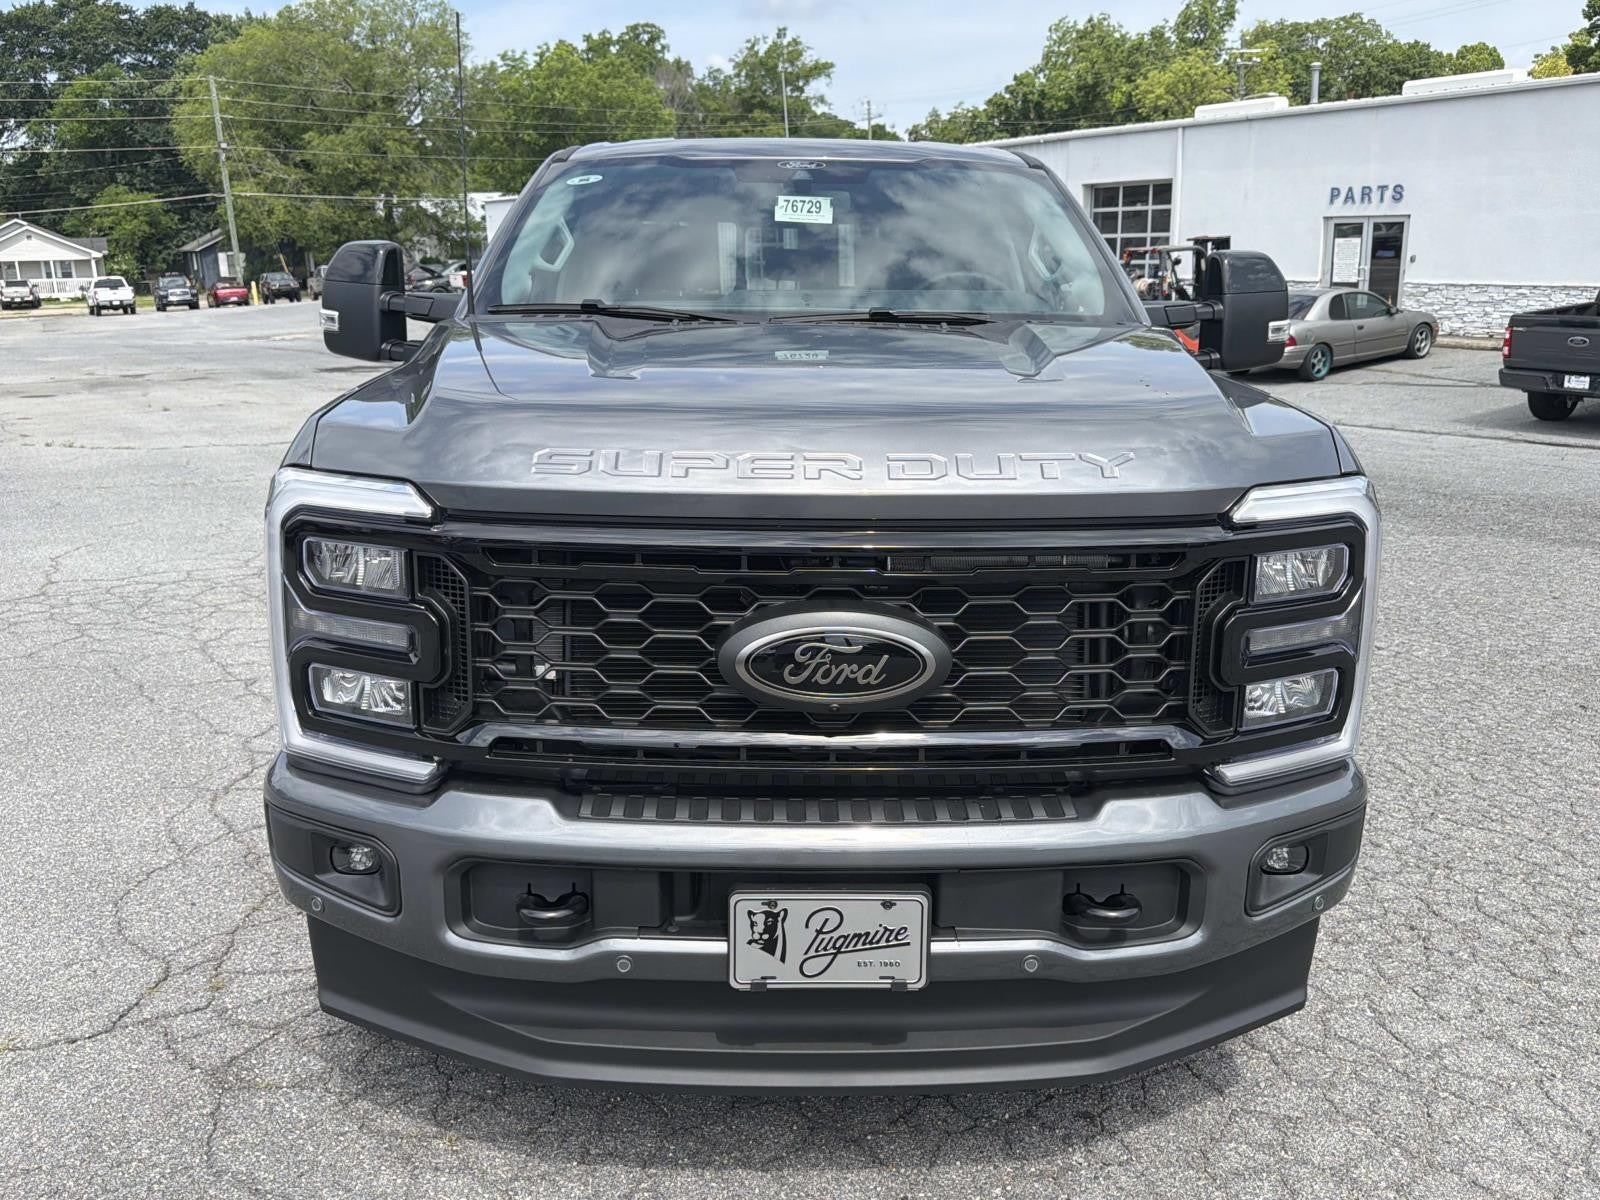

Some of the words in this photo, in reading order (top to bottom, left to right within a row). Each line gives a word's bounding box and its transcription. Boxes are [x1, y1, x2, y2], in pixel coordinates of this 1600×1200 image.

[783, 199, 822, 214] 76729
[1329, 184, 1404, 205] PARTS
[531, 447, 863, 480] SUPER
[886, 452, 1136, 481] DUTY
[783, 642, 889, 685] Ford
[799, 906, 911, 978] Pugmire
[857, 960, 875, 968] EST.
